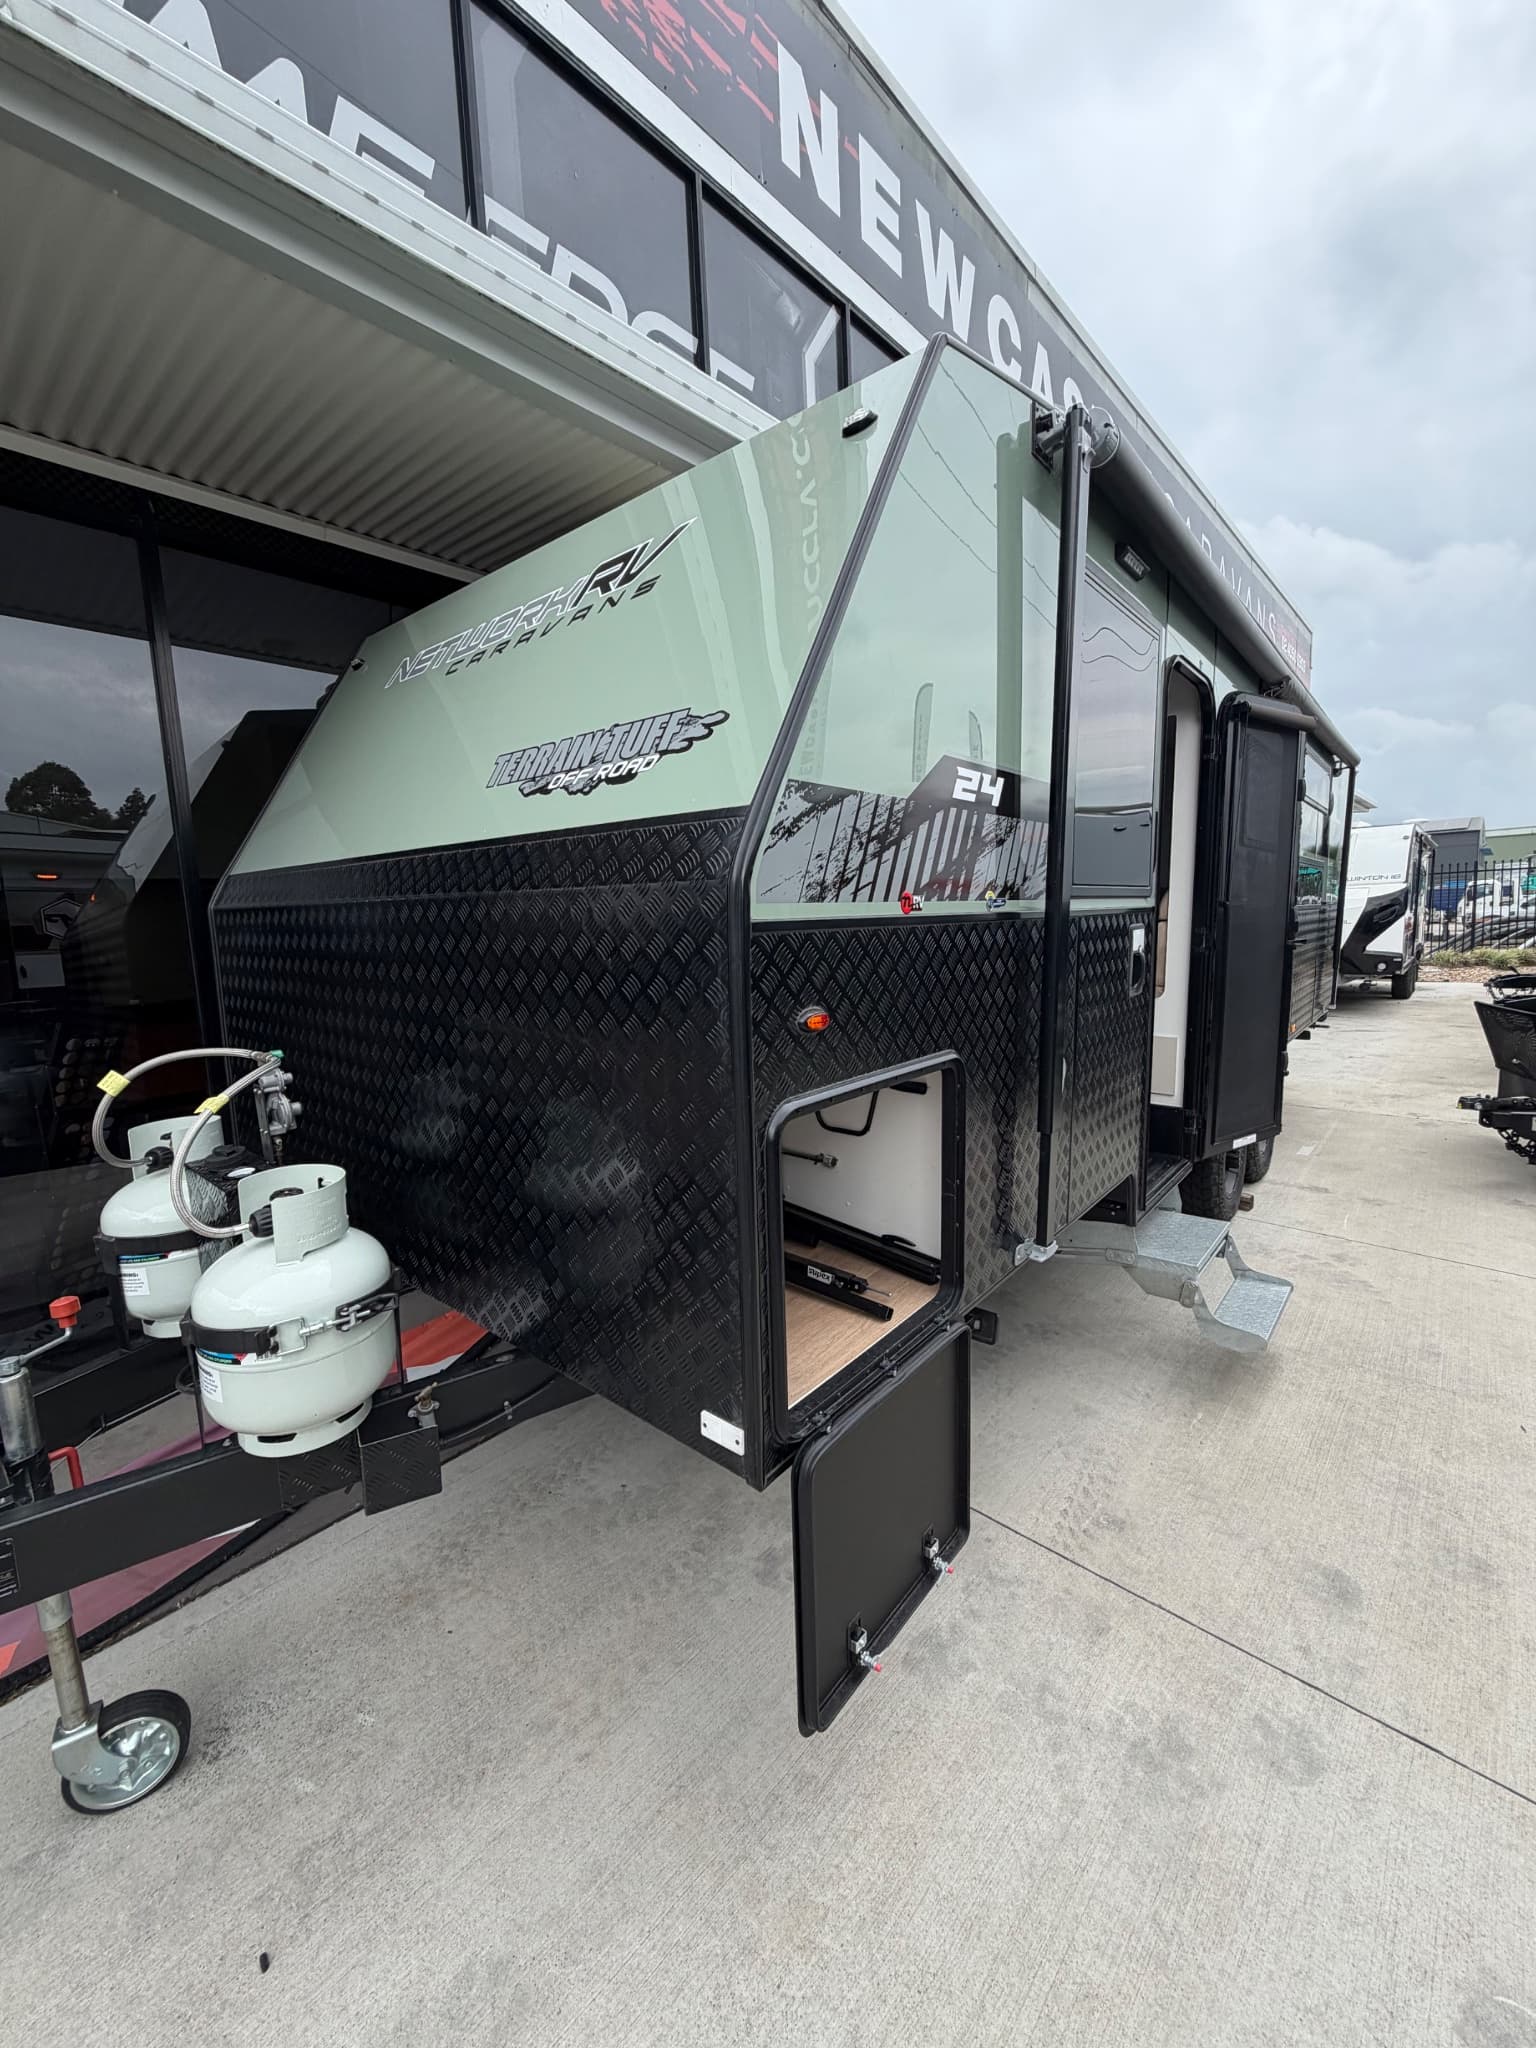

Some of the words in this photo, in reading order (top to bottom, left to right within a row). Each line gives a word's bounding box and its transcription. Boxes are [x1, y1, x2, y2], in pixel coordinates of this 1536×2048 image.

[445, 574, 661, 676] CARAVANS
[548, 769, 592, 790] OFF
[593, 754, 660, 781] ROAD
[952, 766, 1005, 807] 24
